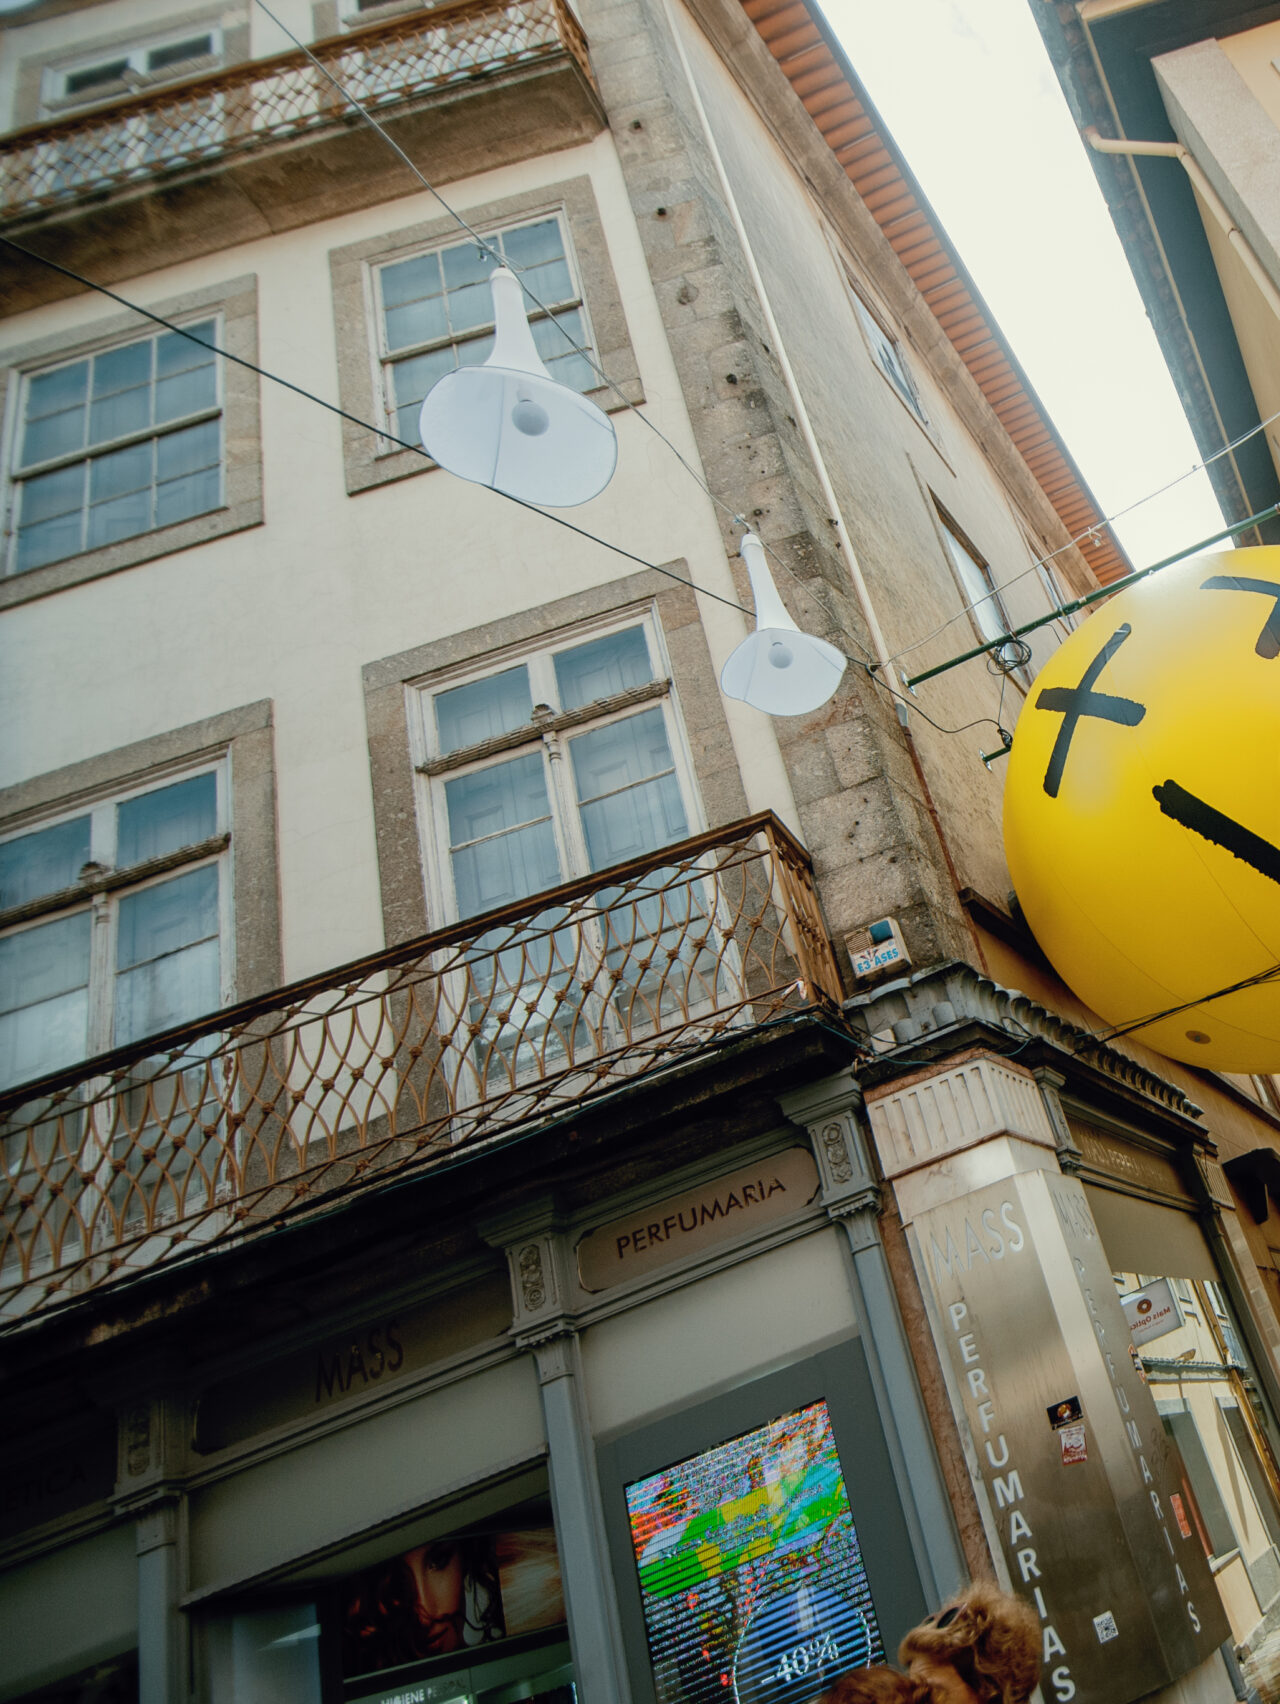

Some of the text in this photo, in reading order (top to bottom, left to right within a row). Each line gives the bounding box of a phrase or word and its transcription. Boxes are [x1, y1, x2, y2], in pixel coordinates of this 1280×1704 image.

[615, 1176, 787, 1260] PERFUMARIA
[929, 1200, 1025, 1286] MASS
[314, 1318, 405, 1404] MASS
[948, 1300, 1076, 1702] PERFUMARIAS
[761, 1631, 839, 1684] -40%
